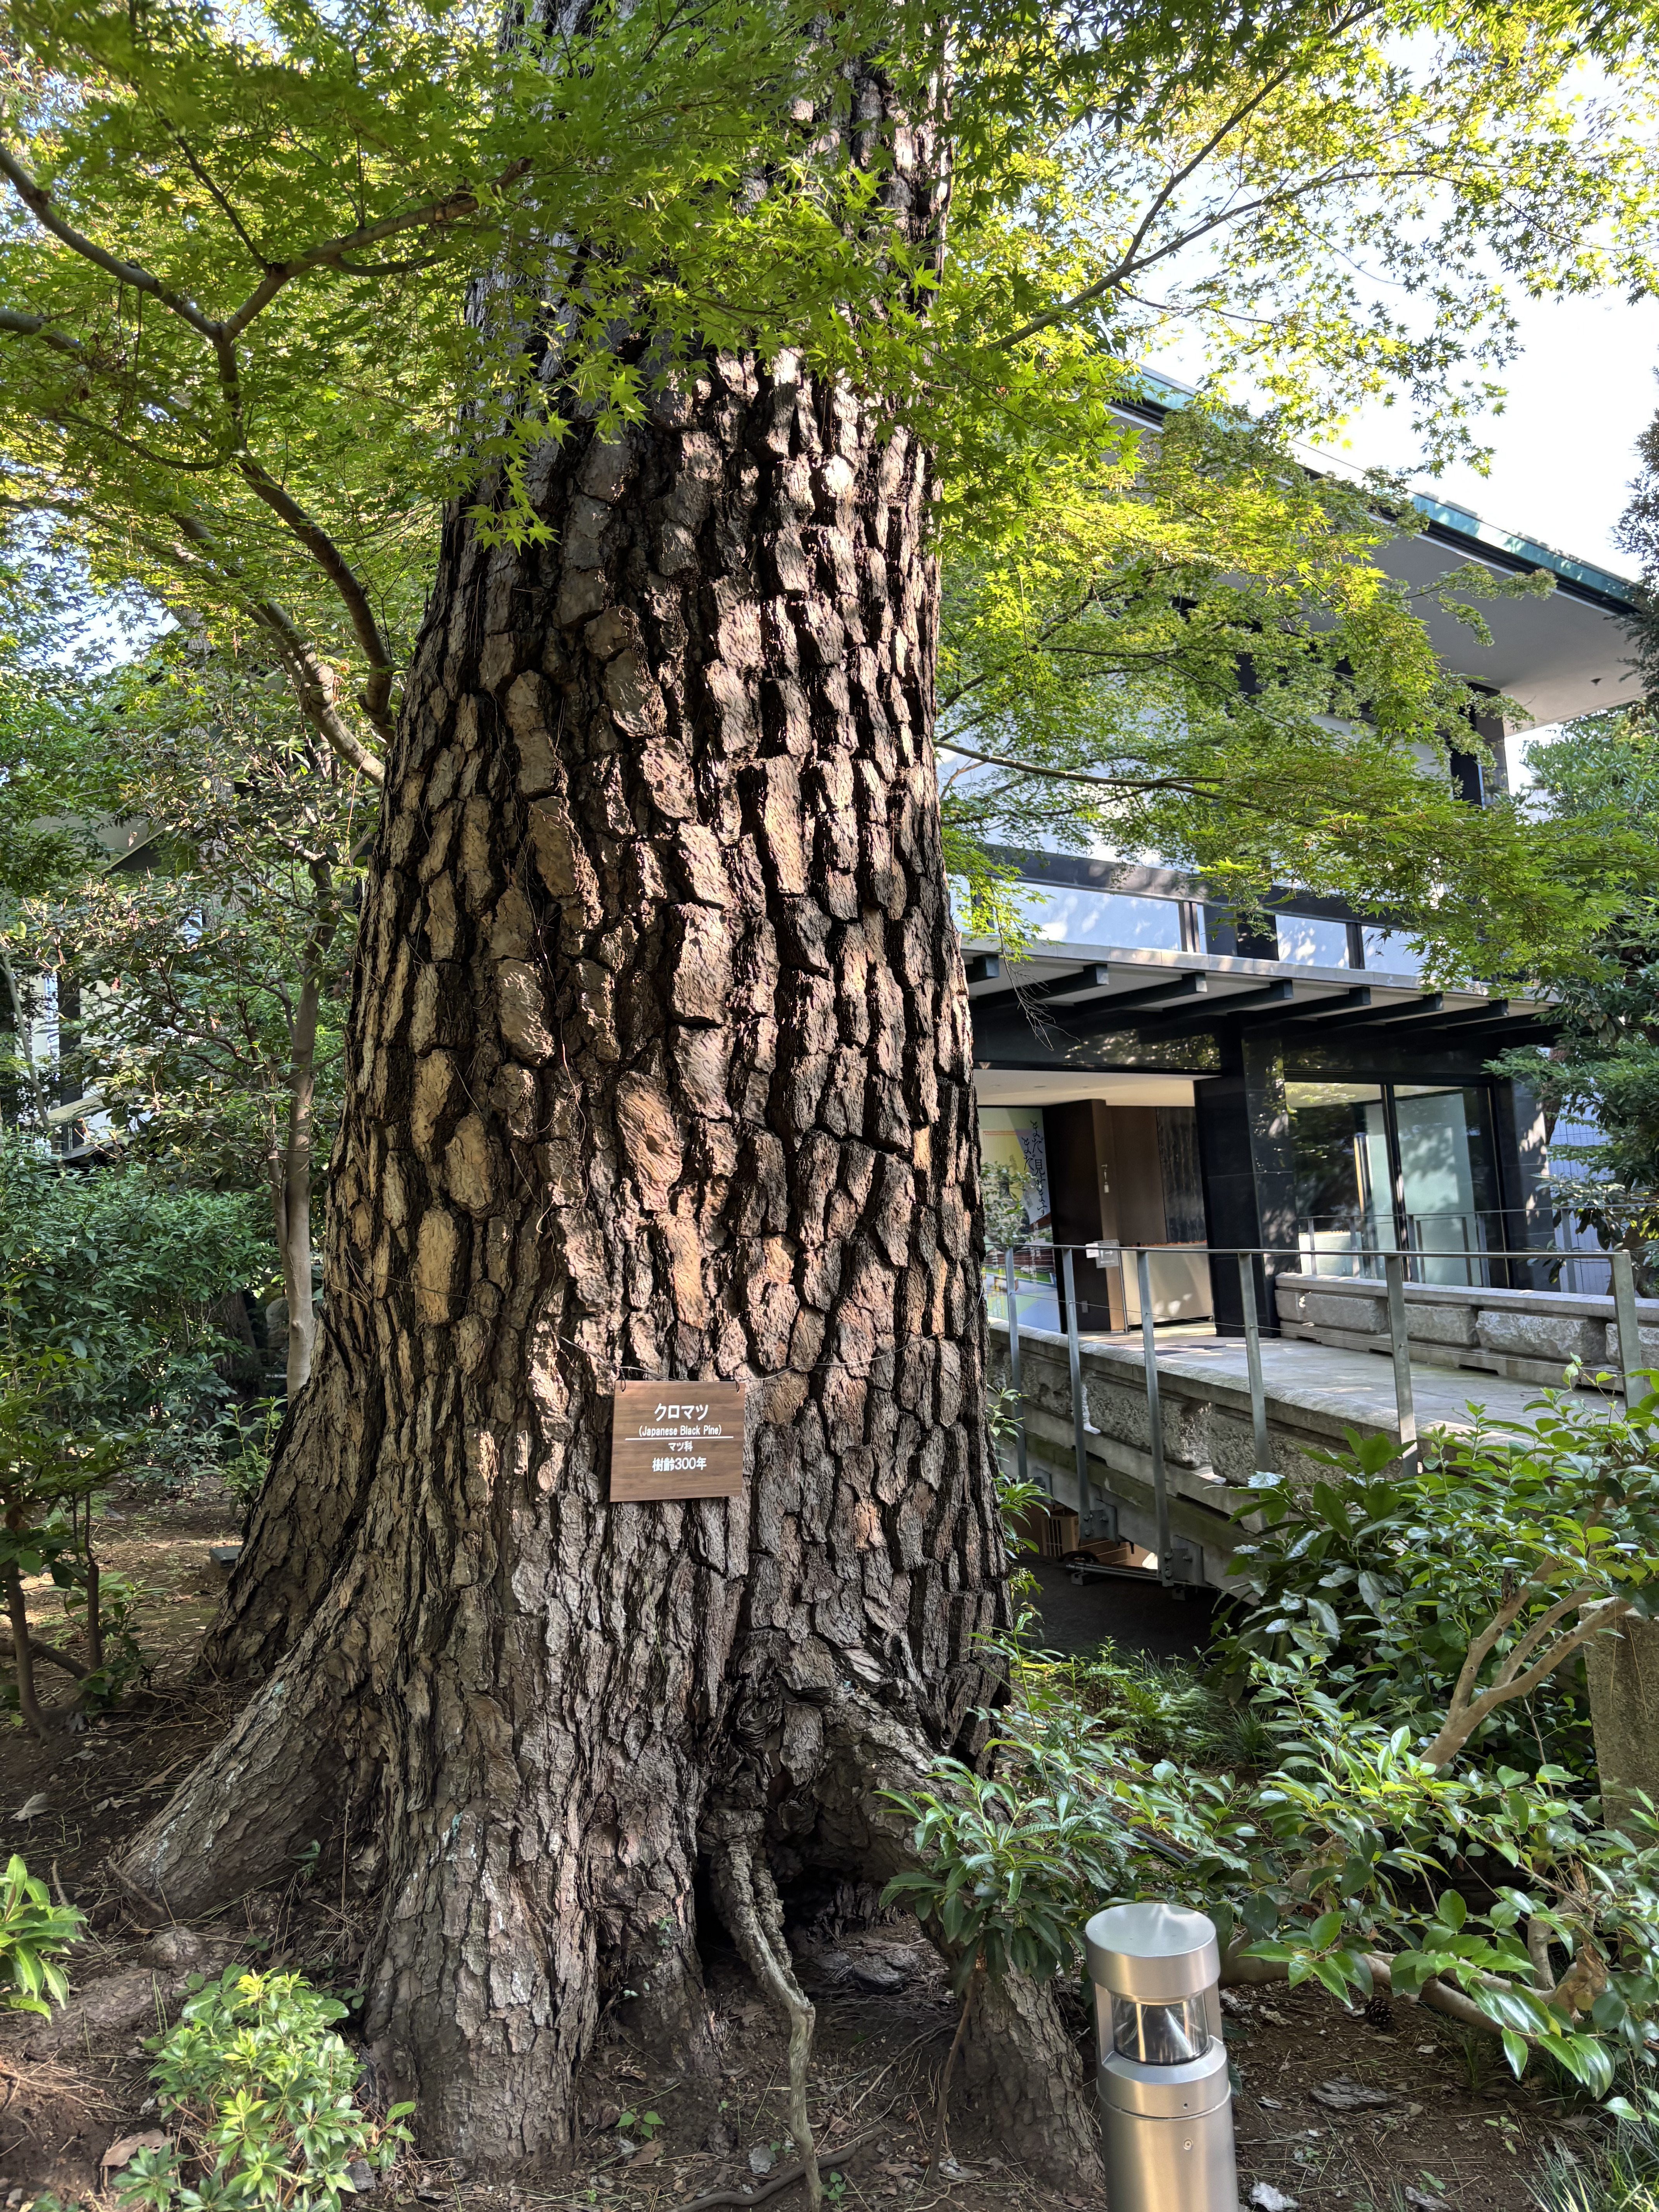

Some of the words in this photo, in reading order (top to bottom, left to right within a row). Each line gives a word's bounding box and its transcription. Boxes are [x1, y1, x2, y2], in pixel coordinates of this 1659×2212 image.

[654, 1403, 708, 1421] クロマツ
[639, 1425, 677, 1437] (Japanese
[680, 1425, 700, 1435] Black
[703, 1424, 721, 1436] Pine)
[668, 1441, 693, 1451] マツ科
[652, 1456, 707, 1472] 樹齢300年
